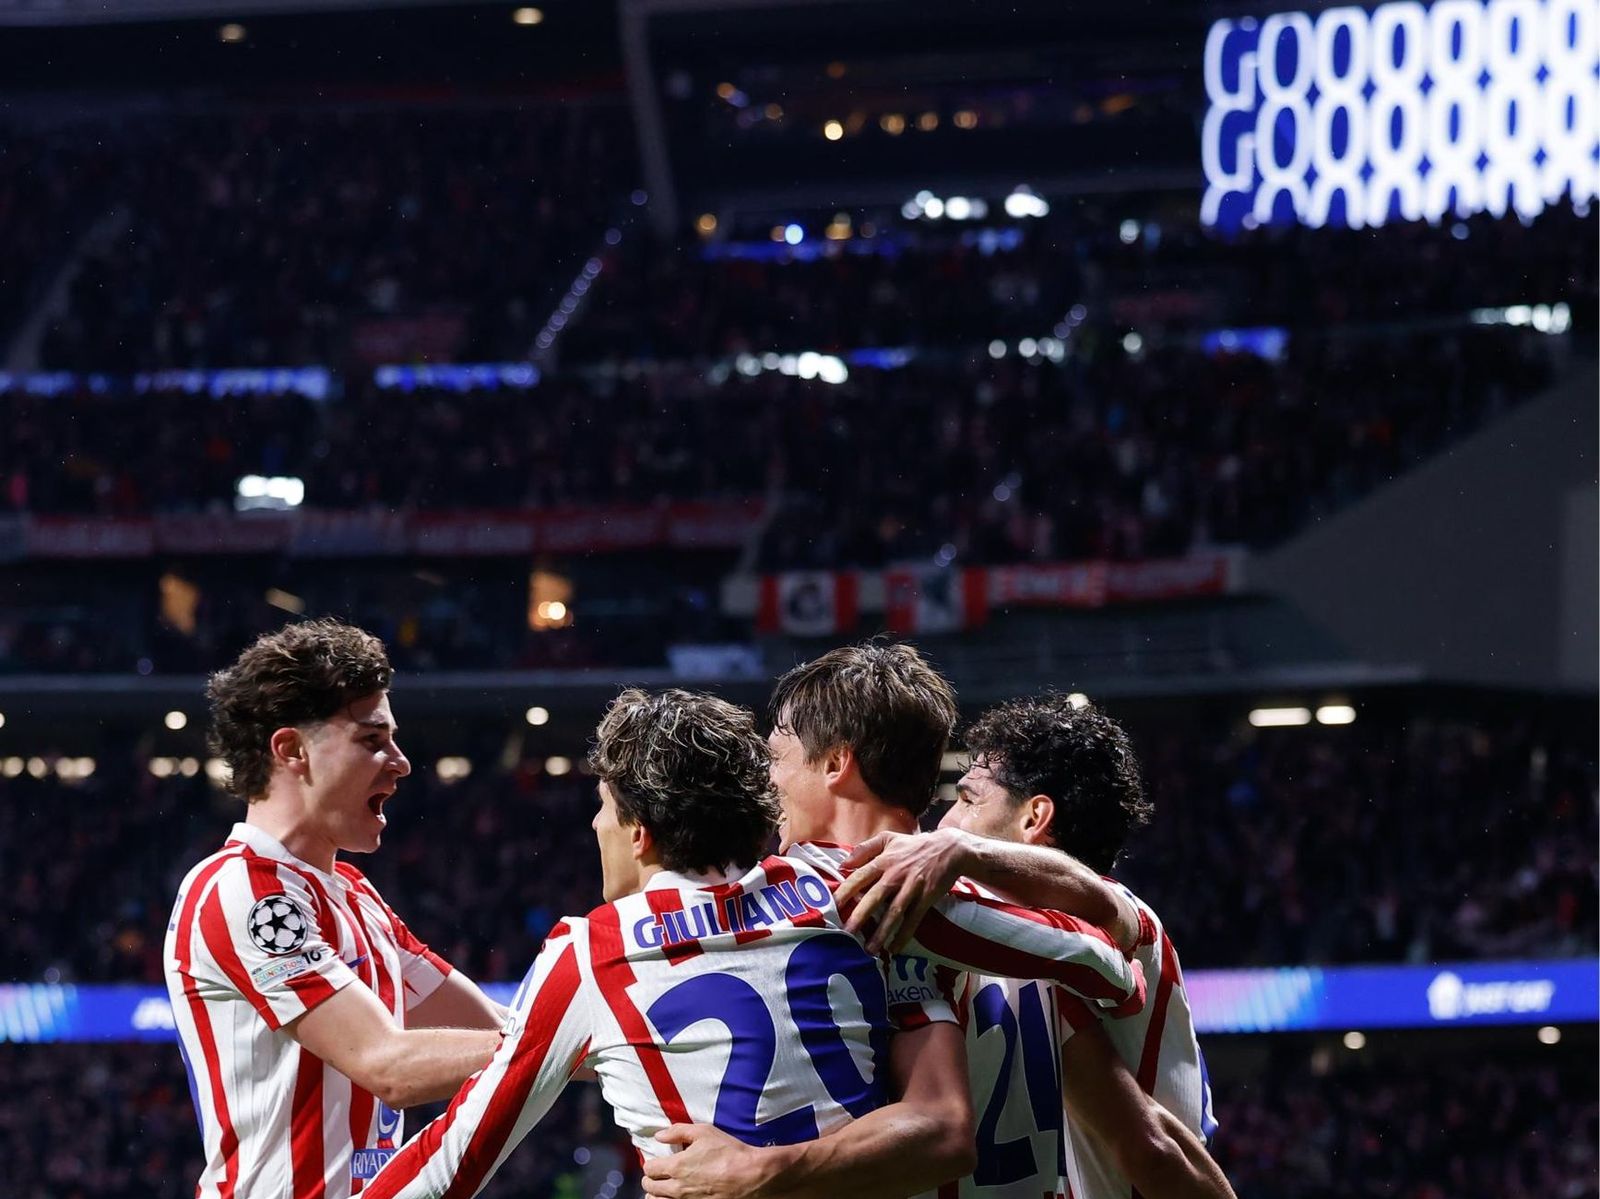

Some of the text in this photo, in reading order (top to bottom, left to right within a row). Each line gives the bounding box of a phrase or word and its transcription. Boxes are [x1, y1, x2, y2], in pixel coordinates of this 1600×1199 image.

[633, 874, 830, 949] GIULIANO
[646, 933, 888, 1148] 20
[353, 1151, 396, 1175] RIYAD
